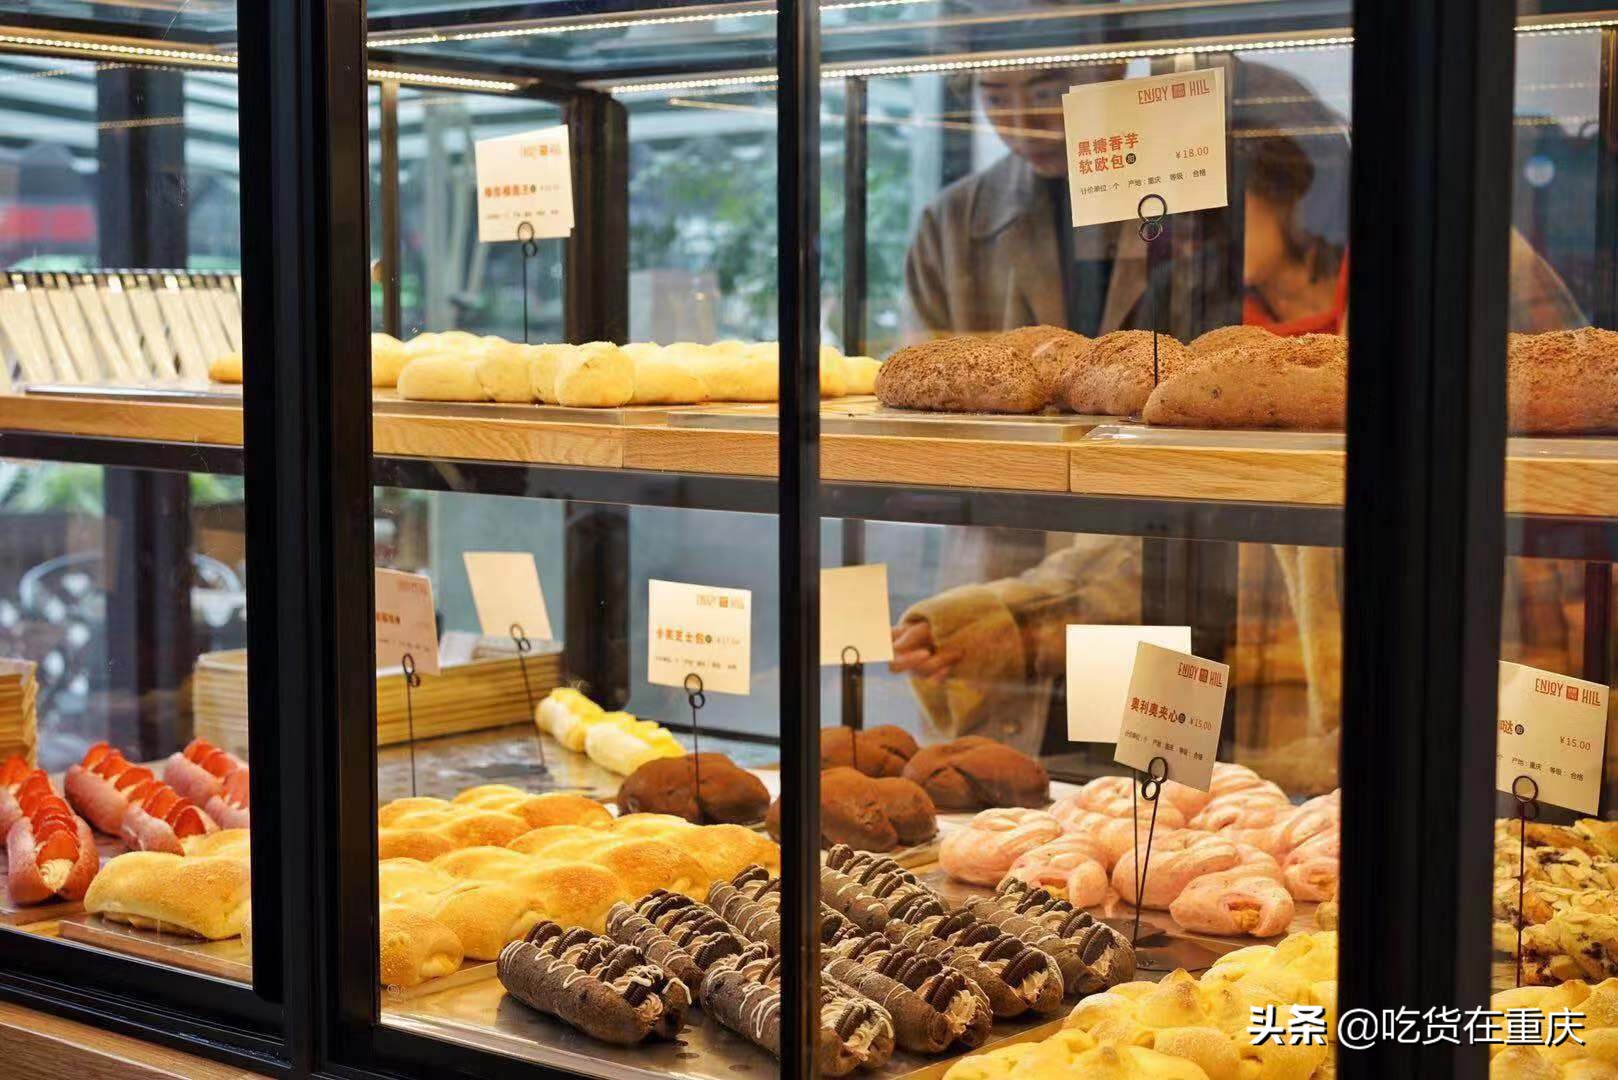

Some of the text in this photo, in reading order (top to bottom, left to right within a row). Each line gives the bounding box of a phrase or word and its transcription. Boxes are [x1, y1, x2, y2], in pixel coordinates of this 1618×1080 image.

[1138, 86, 1170, 105] ENJOY
[1189, 80, 1211, 97] HILL
[1078, 132, 1140, 157] 黑糖香芋
[1175, 146, 1210, 160] ¥18.00
[1079, 154, 1125, 175] 软欧包
[1177, 662, 1199, 681] ENJOY
[1209, 671, 1223, 688] HILL
[1535, 678, 1564, 698] ENJOY
[1581, 688, 1601, 707] HILL
[1130, 697, 1178, 724] 奥利奥夹心
[1560, 736, 1591, 751] ¥15.00
